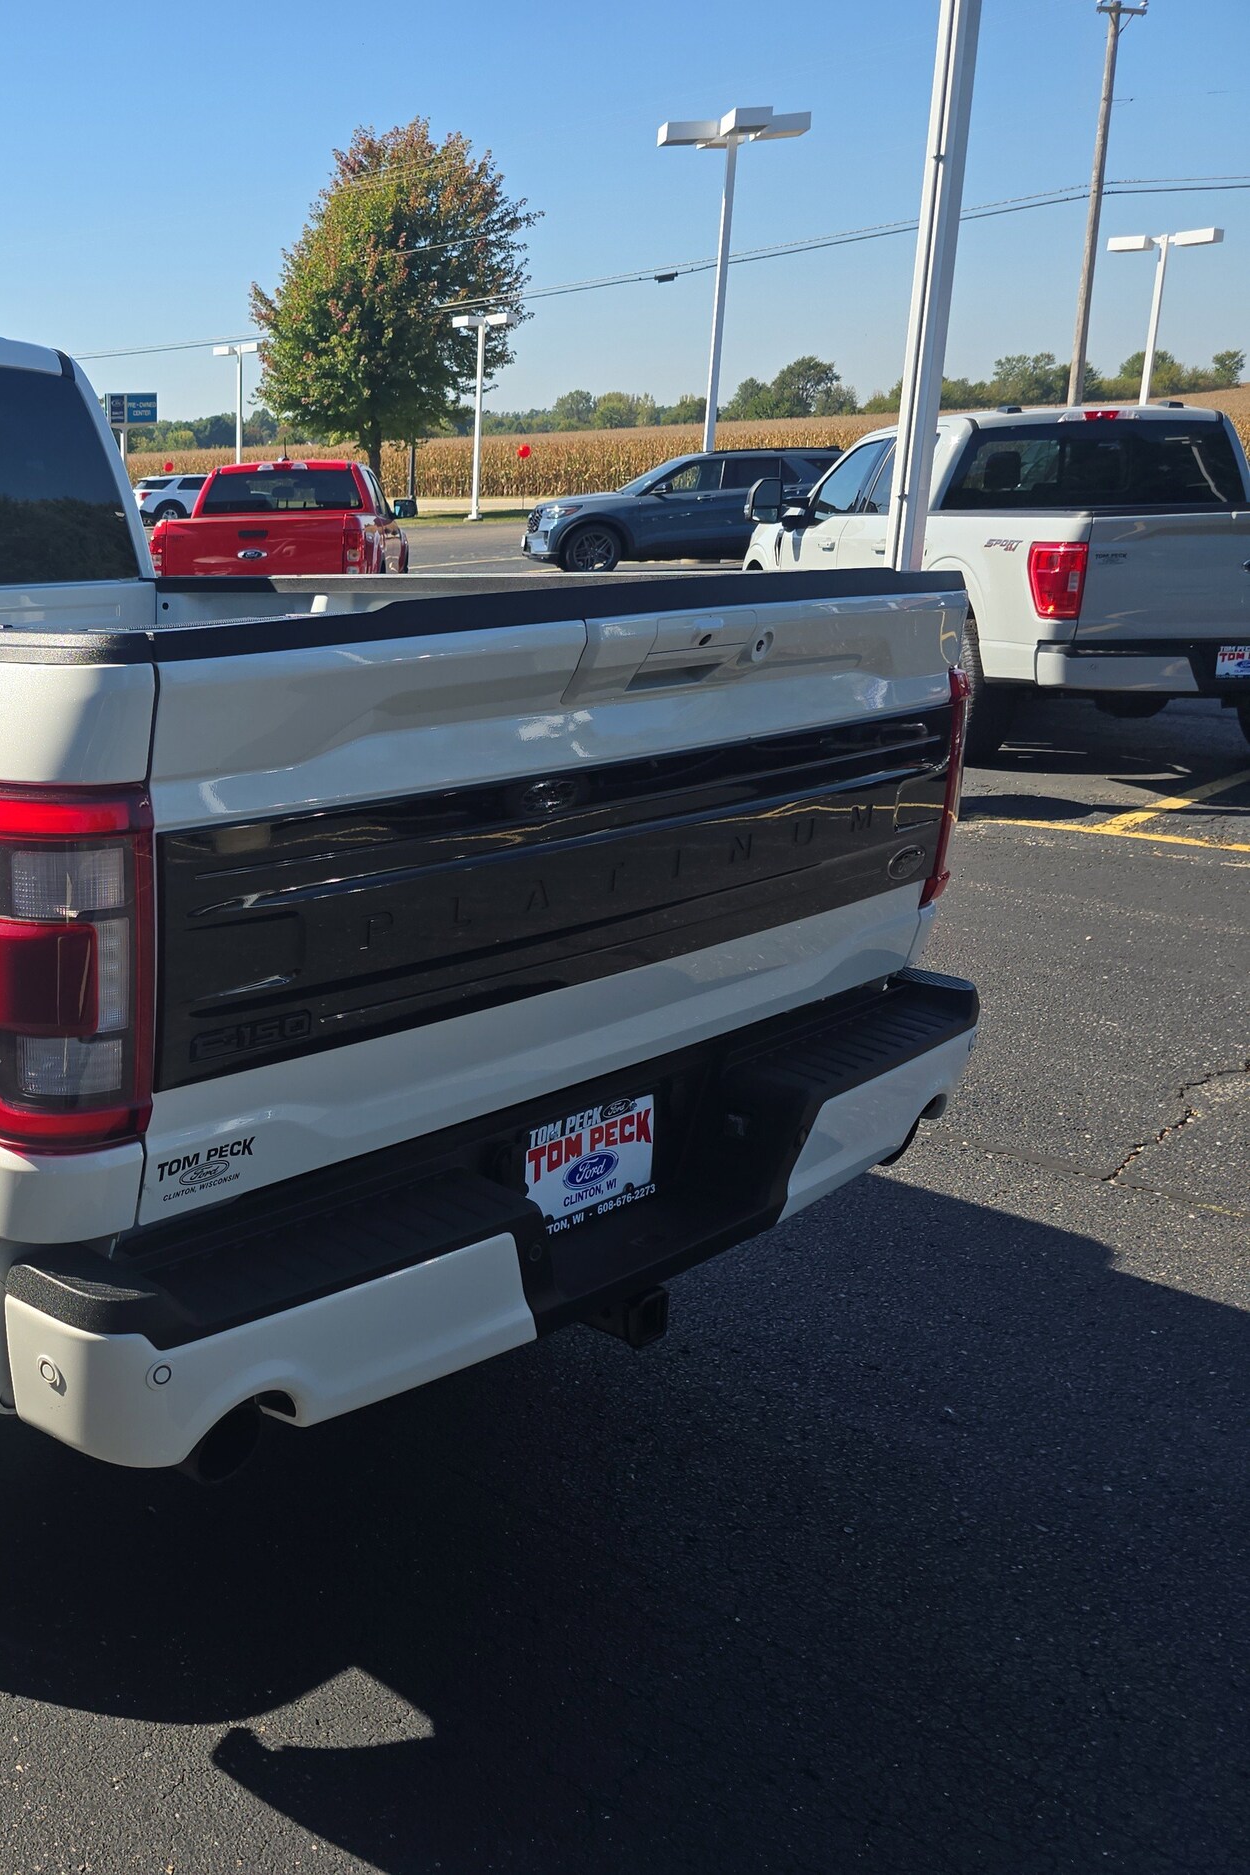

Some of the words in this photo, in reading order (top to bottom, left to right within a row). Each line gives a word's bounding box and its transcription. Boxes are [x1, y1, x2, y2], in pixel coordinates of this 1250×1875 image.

[1219, 652, 1245, 663] TOM
[358, 803, 875, 952] PLATINUM
[529, 1120, 562, 1149] TOM
[565, 1105, 603, 1136] PECK
[157, 1152, 200, 1182] TOM
[206, 1136, 256, 1161] PECK
[528, 1132, 582, 1184] TOM
[589, 1108, 652, 1152] PECK
[163, 1186, 197, 1201] CLINTON,
[199, 1172, 241, 1190] WISCONSIN
[190, 1165, 220, 1180] Ford
[576, 1156, 606, 1183] Ford
[563, 1184, 603, 1207] CLINTON,
[606, 1178, 617, 1190] WI
[573, 1212, 584, 1224] WI
[597, 1183, 656, 1215] 608-676-2273
